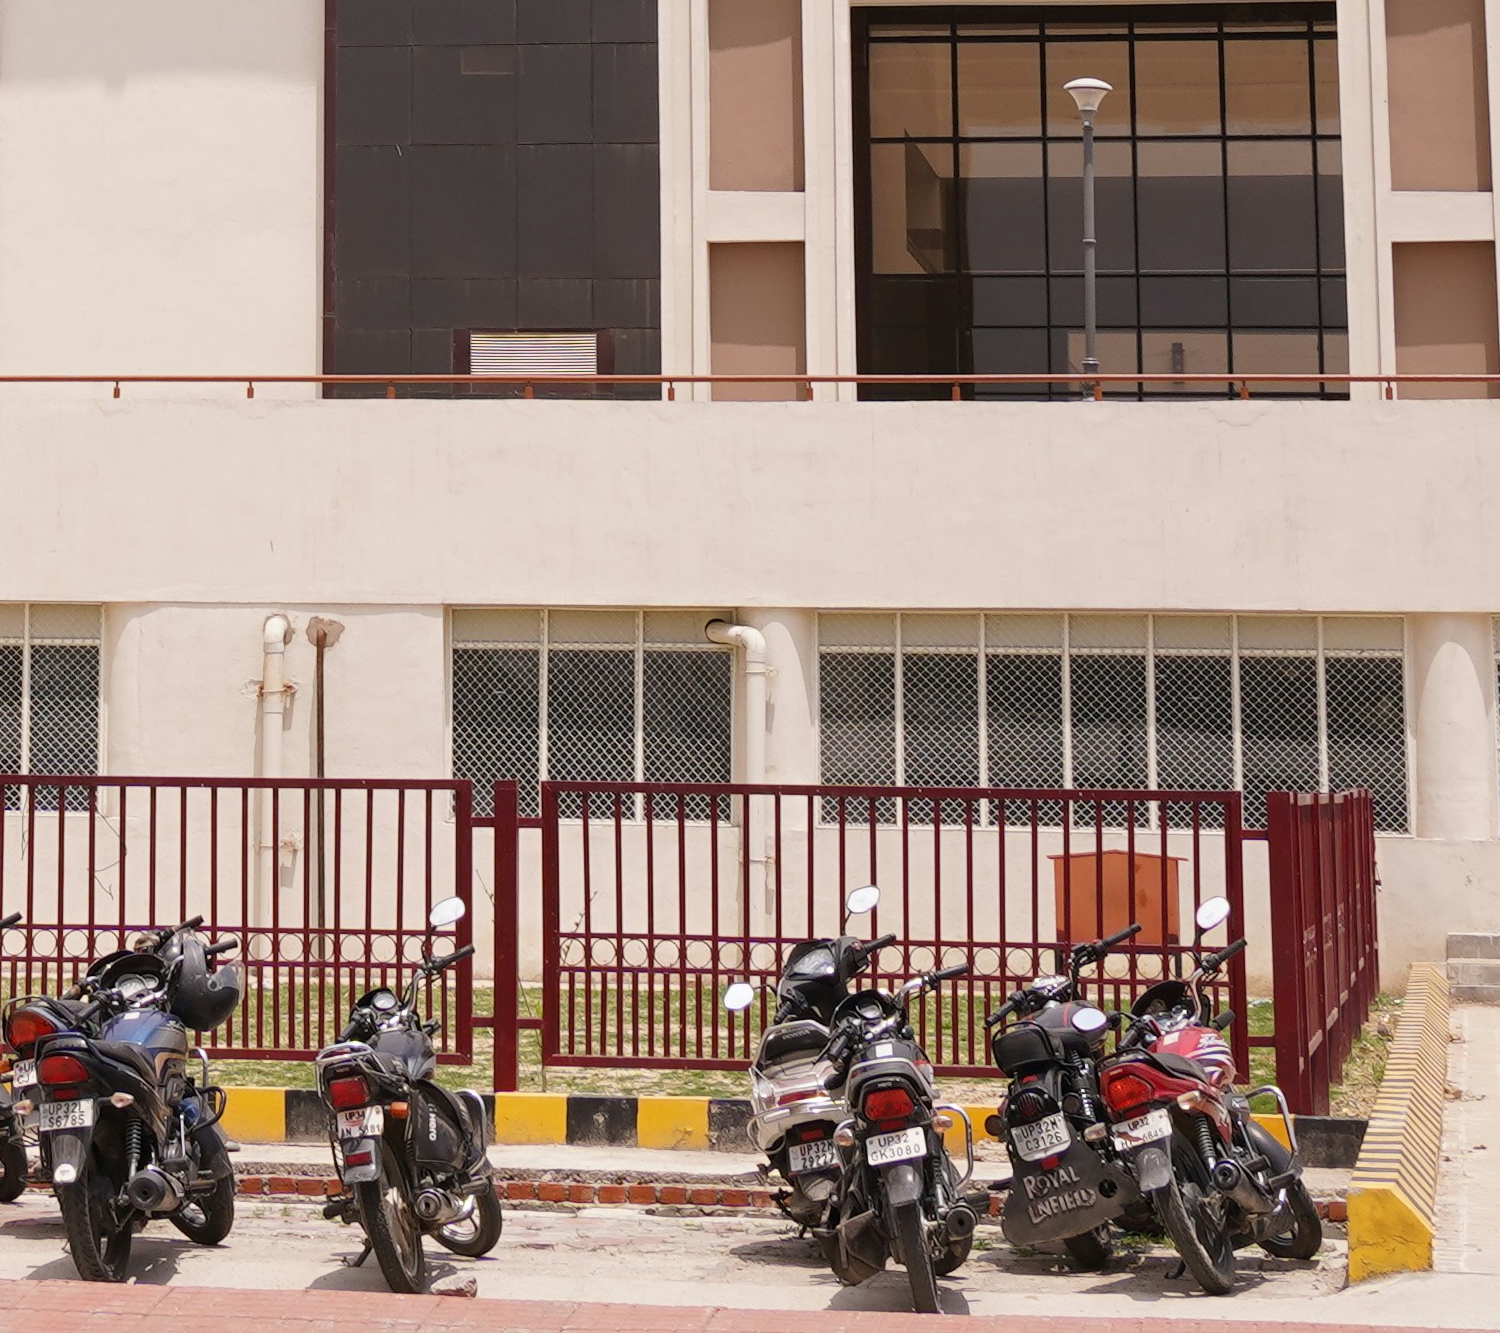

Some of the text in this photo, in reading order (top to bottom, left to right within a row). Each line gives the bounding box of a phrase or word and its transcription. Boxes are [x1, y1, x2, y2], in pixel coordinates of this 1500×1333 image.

[48, 1102, 85, 1116] UP32L
[878, 1134, 909, 1147] UP32
[870, 1144, 920, 1162] GK3080
[1023, 1166, 1080, 1199] ROYAL
